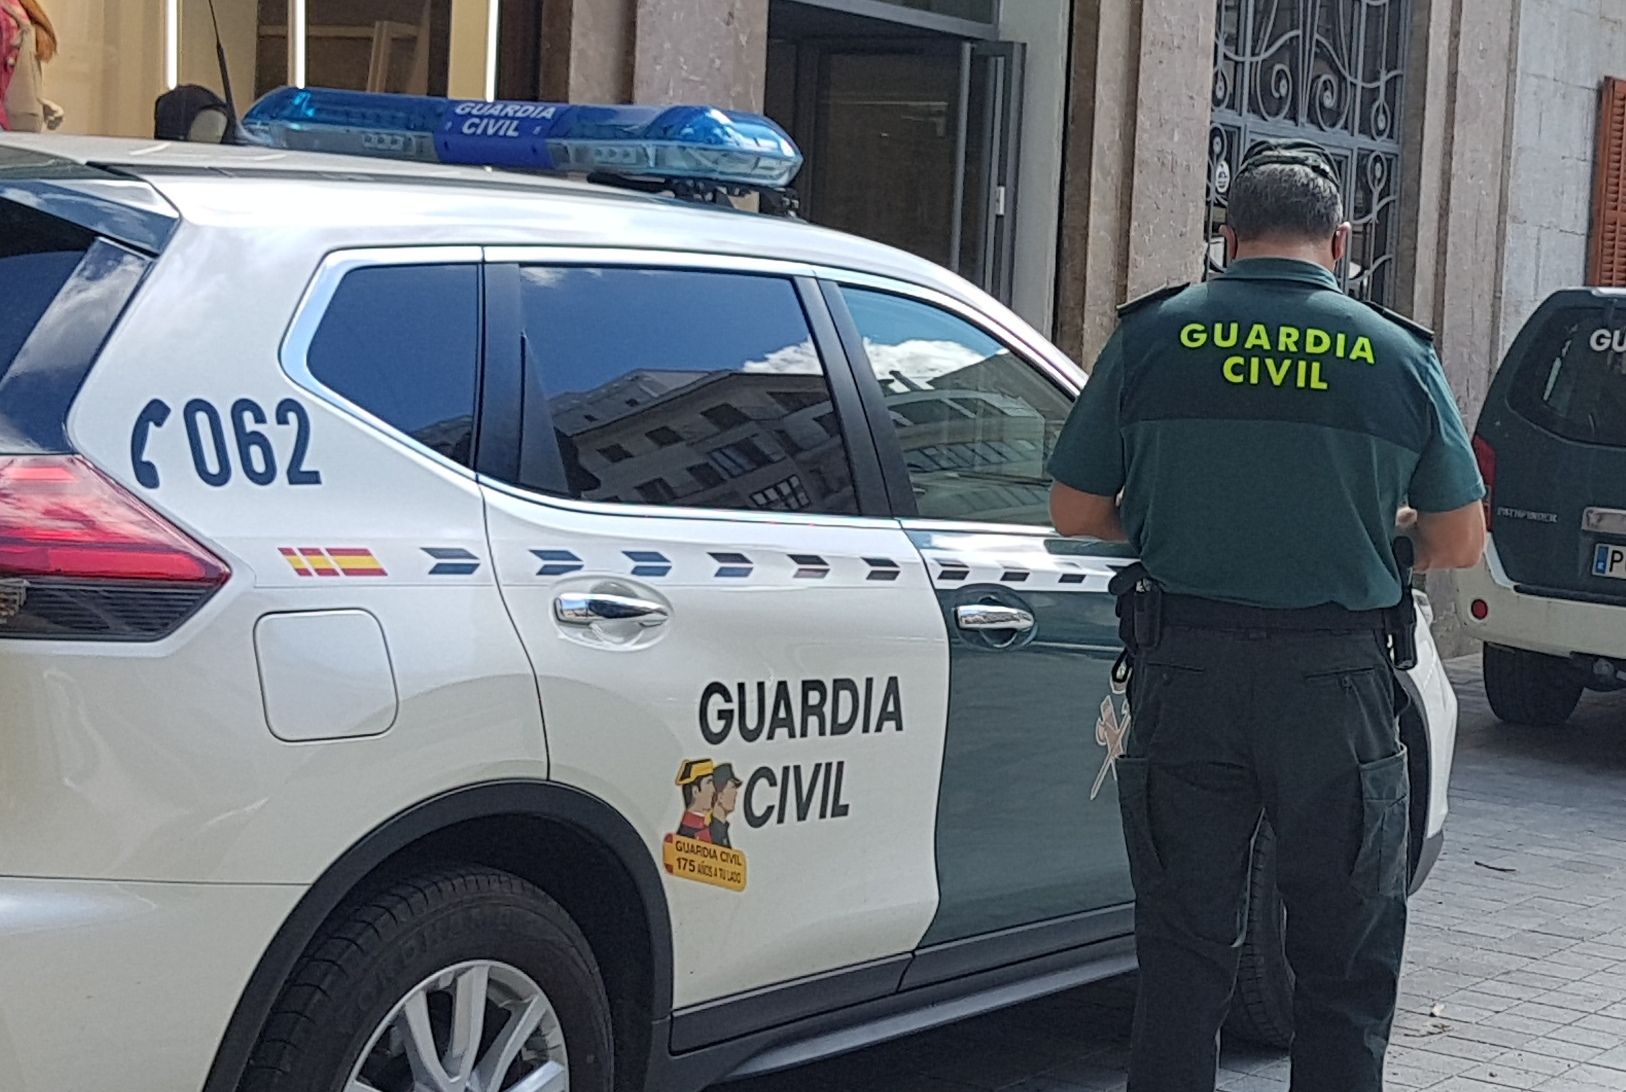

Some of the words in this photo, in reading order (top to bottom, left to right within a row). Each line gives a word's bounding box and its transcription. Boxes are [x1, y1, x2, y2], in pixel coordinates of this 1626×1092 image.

[455, 102, 556, 119] GUARDIA
[462, 117, 520, 137] CIVIL
[1180, 322, 1375, 364] GUARDIA
[1222, 355, 1328, 389] CIVIL
[183, 398, 322, 487] 062
[1608, 549, 1626, 573] P
[699, 676, 903, 745] GUARDIA
[743, 760, 849, 829] CIVIL
[675, 840, 718, 861] GUARDIA
[719, 850, 743, 866] CIVIL
[676, 856, 696, 873] 175
